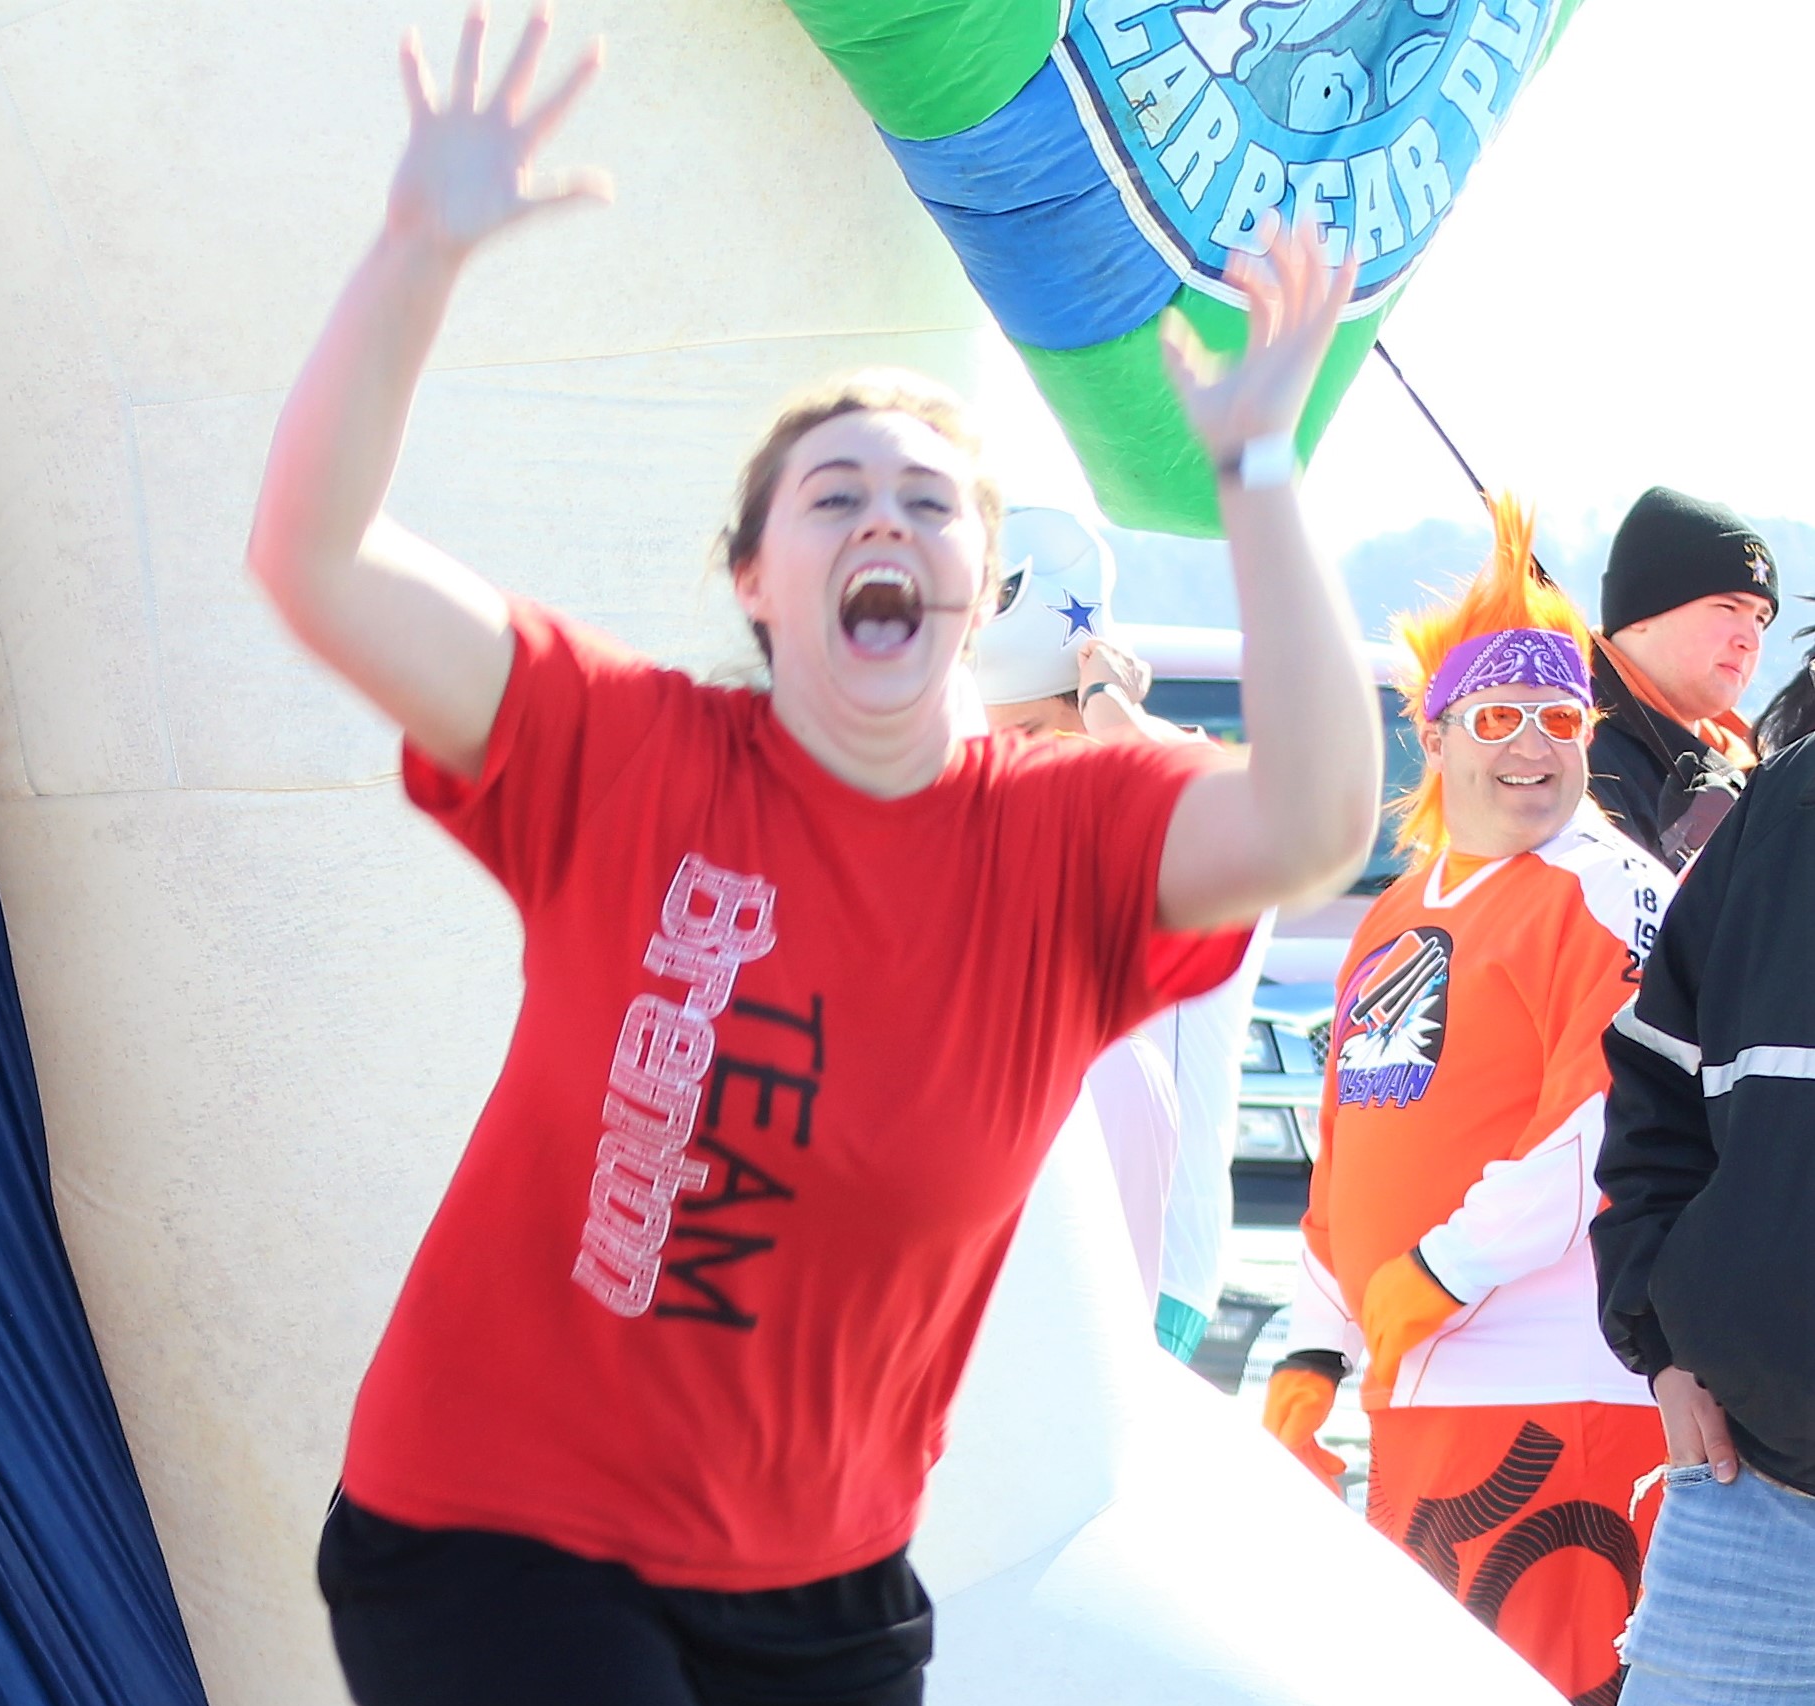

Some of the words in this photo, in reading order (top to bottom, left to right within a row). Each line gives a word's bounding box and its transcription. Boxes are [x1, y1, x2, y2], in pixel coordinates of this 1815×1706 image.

[1208, 116, 1453, 270] BEAR
[1634, 887, 1658, 913] 18
[570, 852, 779, 1319] Brenton
[653, 992, 825, 1333] TEAM
